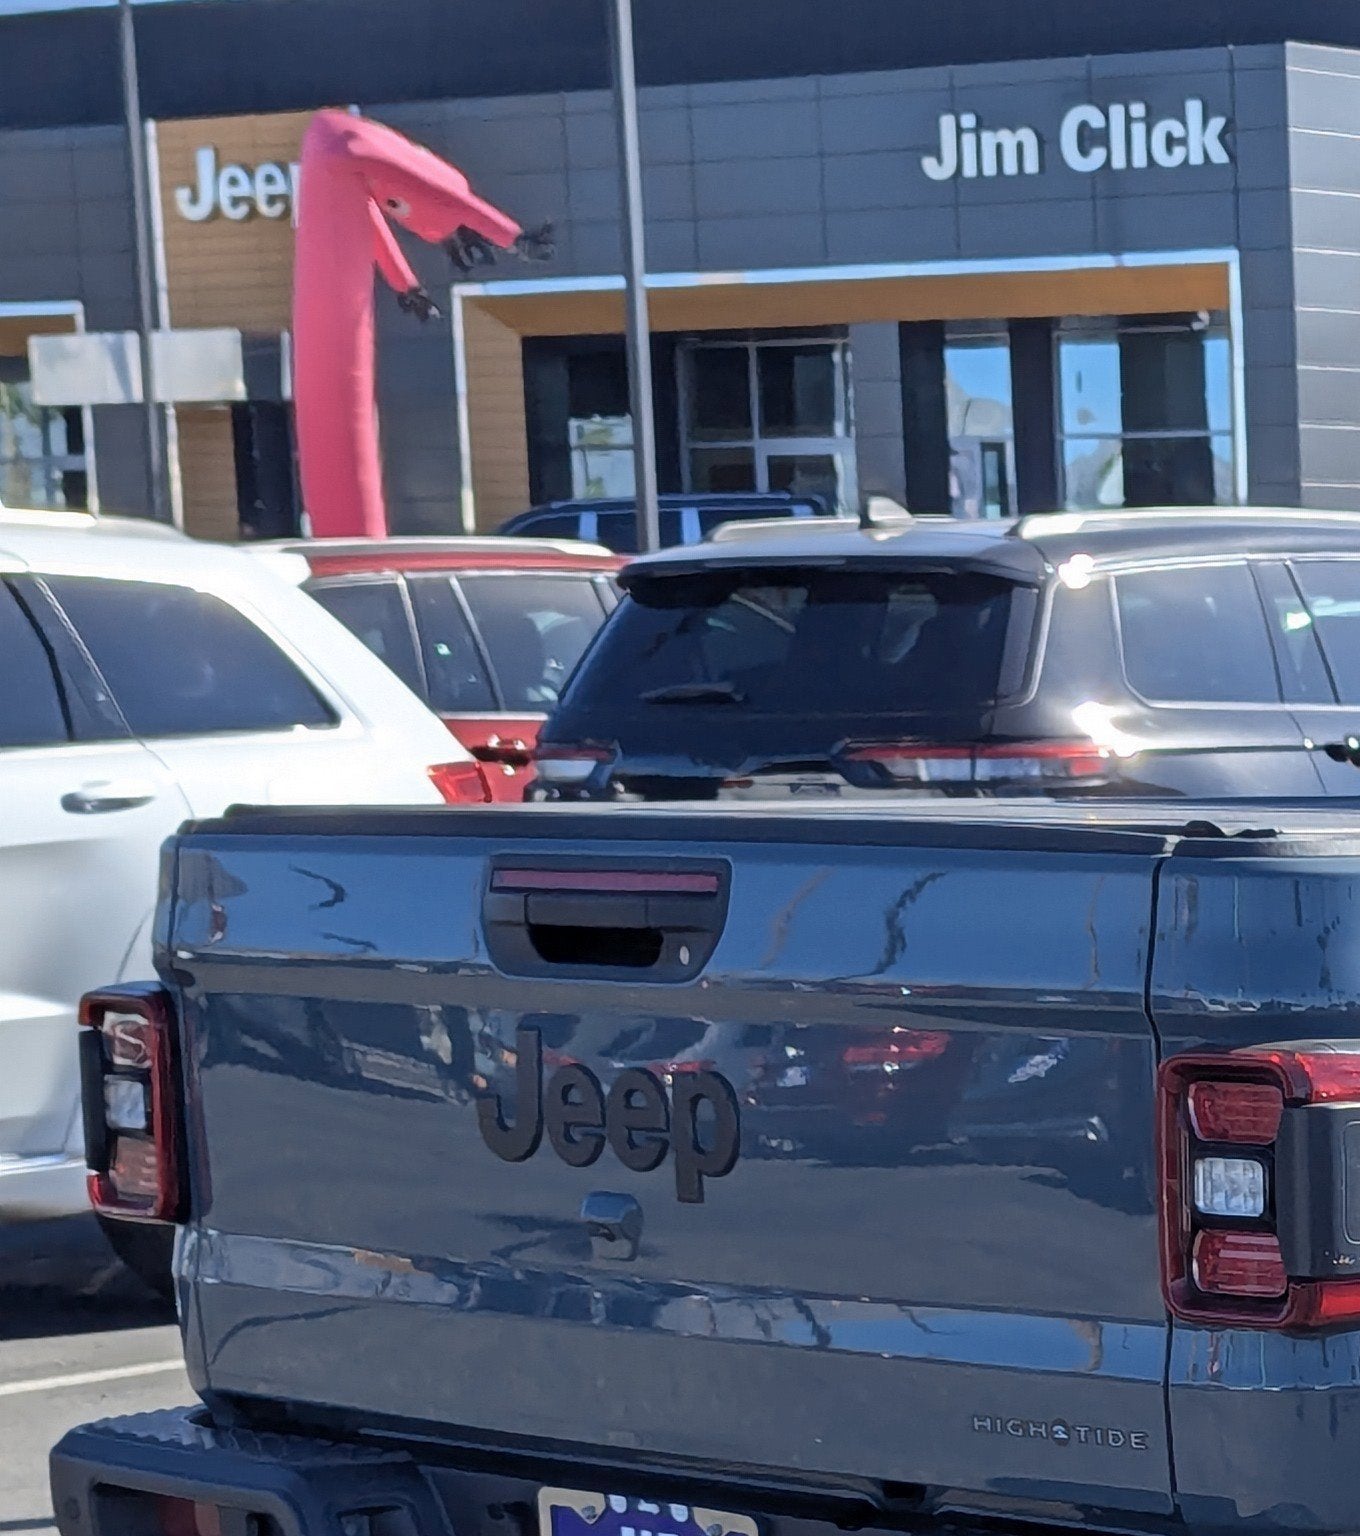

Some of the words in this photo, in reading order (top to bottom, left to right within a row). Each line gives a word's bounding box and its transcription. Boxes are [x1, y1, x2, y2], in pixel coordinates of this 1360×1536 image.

[921, 112, 1040, 181] Jim
[1060, 97, 1230, 172] Click
[476, 1025, 740, 1204] Jeep
[973, 1415, 1048, 1438] HIGH
[1075, 1424, 1149, 1450] TIDE
